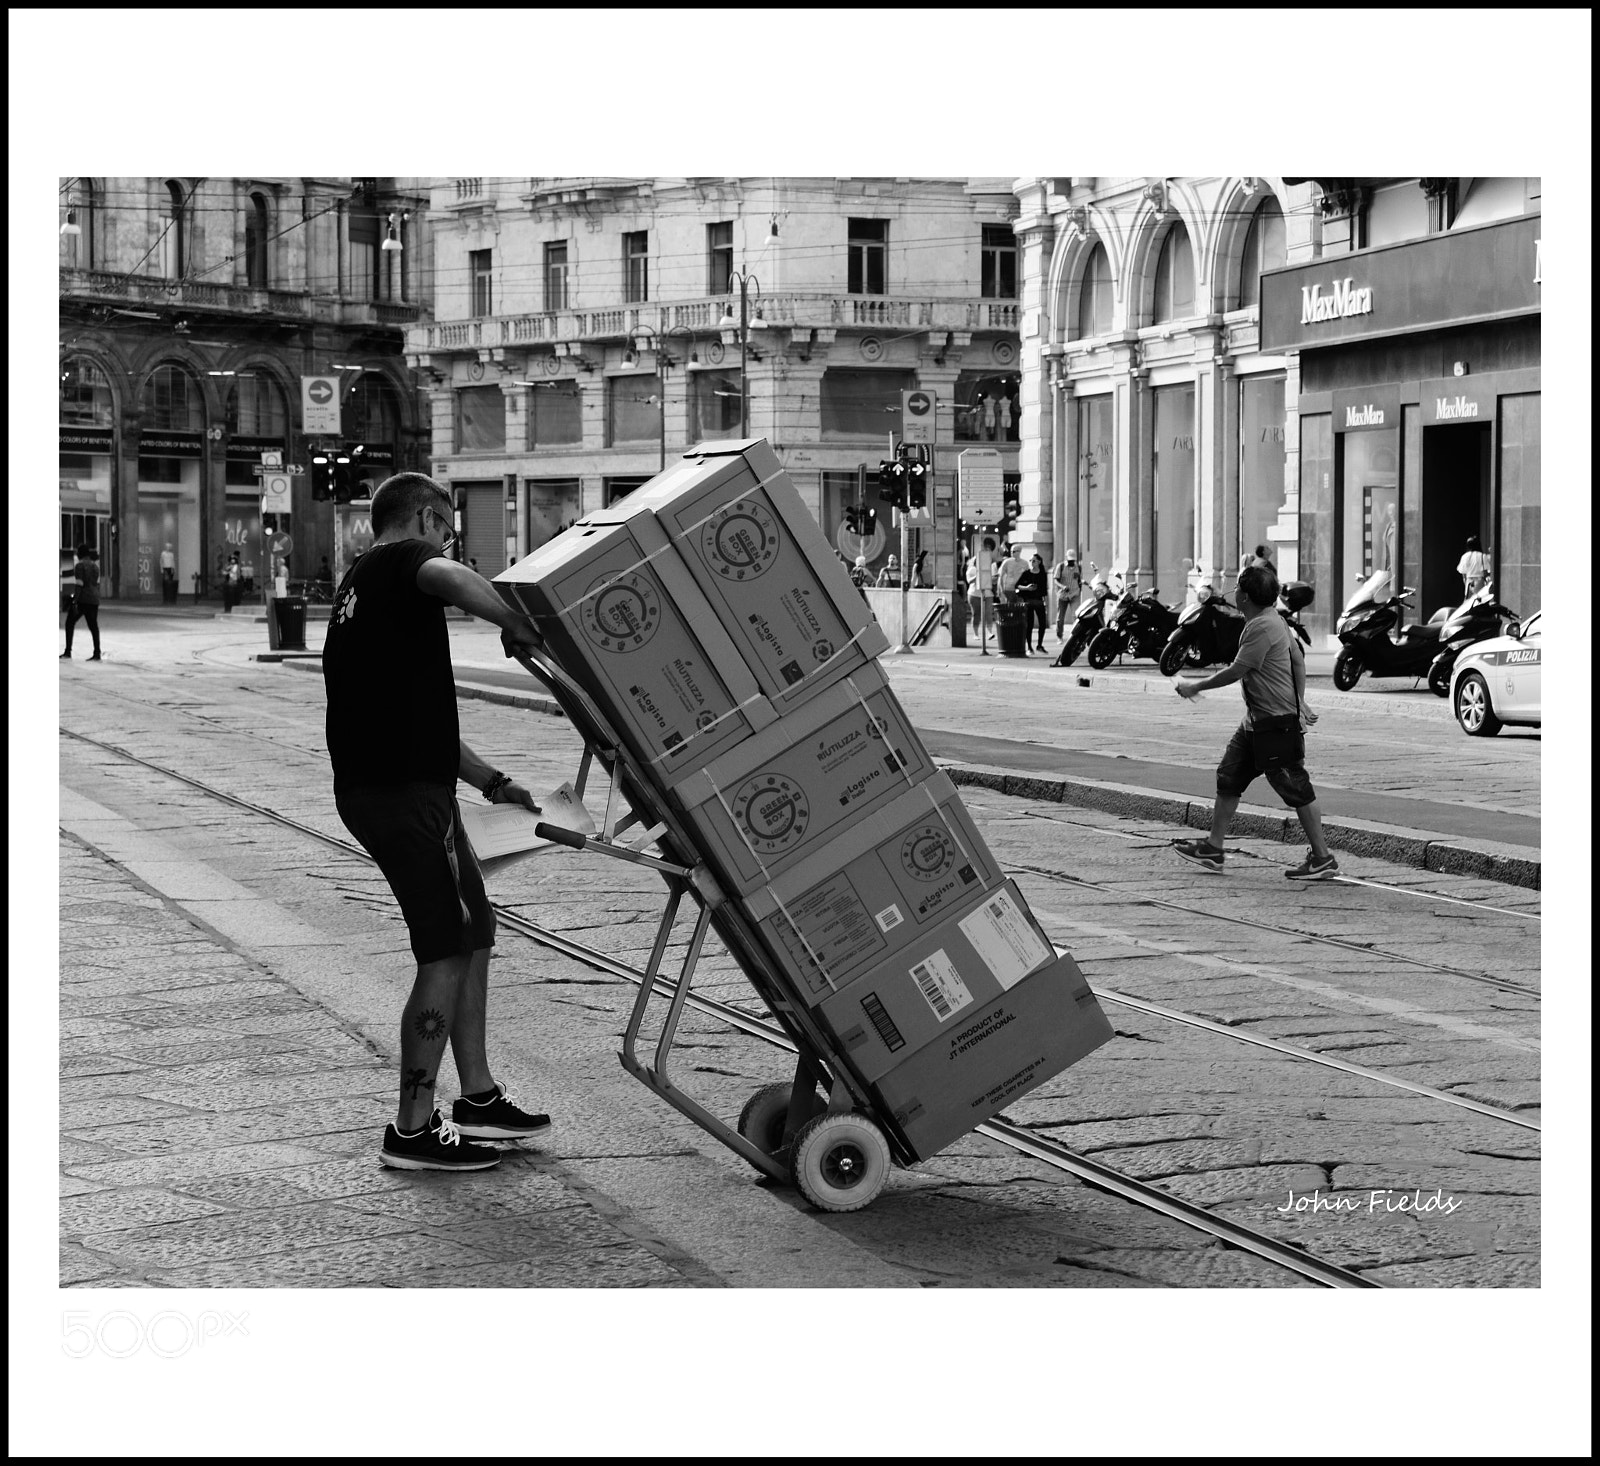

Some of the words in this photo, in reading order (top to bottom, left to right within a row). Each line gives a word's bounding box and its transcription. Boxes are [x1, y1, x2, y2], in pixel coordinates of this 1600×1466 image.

[1301, 278, 1374, 325] MaxMara
[1345, 404, 1385, 427] MaxMara
[1435, 396, 1478, 420] MaxMara
[352, 519, 374, 535] M
[727, 535, 744, 556] BOX
[738, 528, 762, 560] GREEN
[608, 606, 624, 627] BOX
[618, 599, 642, 631] GREEN
[758, 621, 786, 658] Logista
[1506, 649, 1538, 662] POLIZIA
[640, 692, 669, 730] Logista
[846, 768, 882, 796] Logista
[759, 793, 790, 816] GREEN
[766, 811, 785, 826] BOX
[919, 839, 942, 856] GREEN
[924, 852, 939, 863] BOX
[924, 880, 957, 905] Logista
[776, 909, 804, 928] RIUTIZZA
[948, 1049, 959, 1060] JT
[957, 1013, 1017, 1053] INTERNATIONAL
[949, 1039, 957, 1047] A
[956, 1016, 994, 1043] PRODUCT
[992, 1008, 1005, 1019] OF
[970, 1095, 987, 1108] KEEP
[985, 1084, 1003, 1098] THESE
[1002, 1064, 1035, 1088] CIGARETTES
[989, 1091, 1006, 1105] COOL
[1005, 1084, 1017, 1095] DRY
[1016, 1073, 1035, 1087] PLACE
